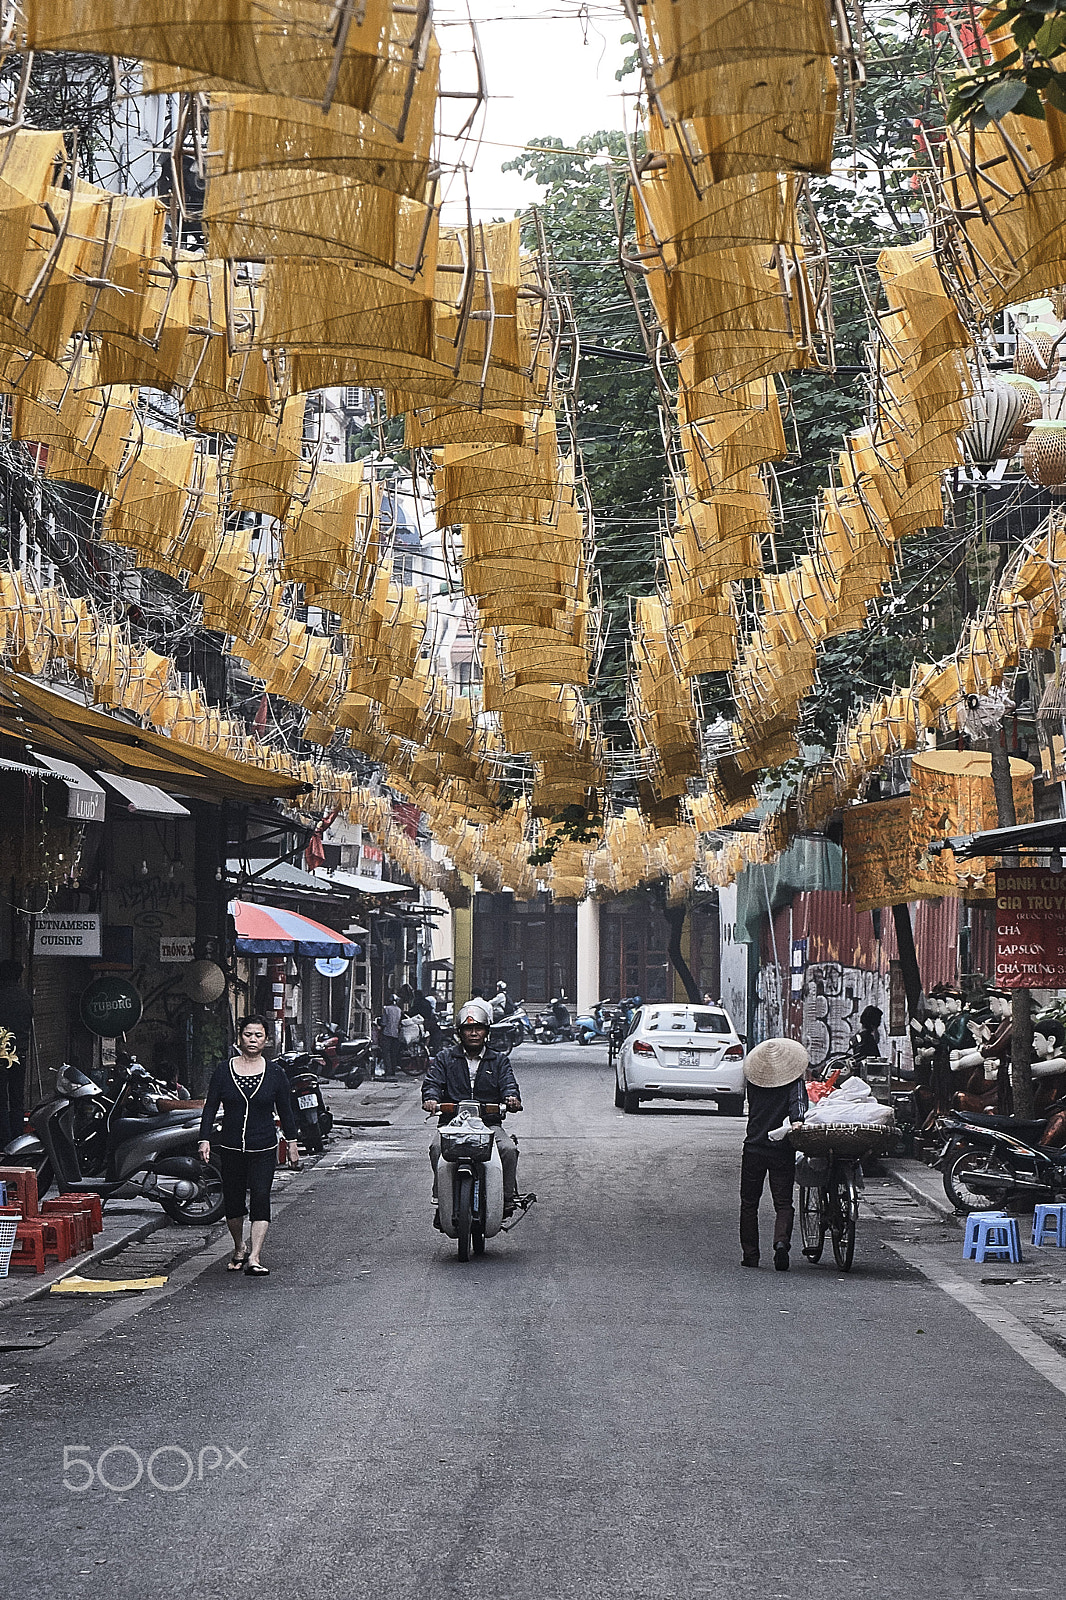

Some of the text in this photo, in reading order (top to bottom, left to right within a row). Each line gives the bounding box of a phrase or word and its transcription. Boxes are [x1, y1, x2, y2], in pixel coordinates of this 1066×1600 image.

[997, 896, 1066, 909] GIA TRUY
[35, 920, 95, 930] IETNAMESE
[40, 935, 83, 946] CUISINE
[93, 998, 132, 1012] TUBORG
